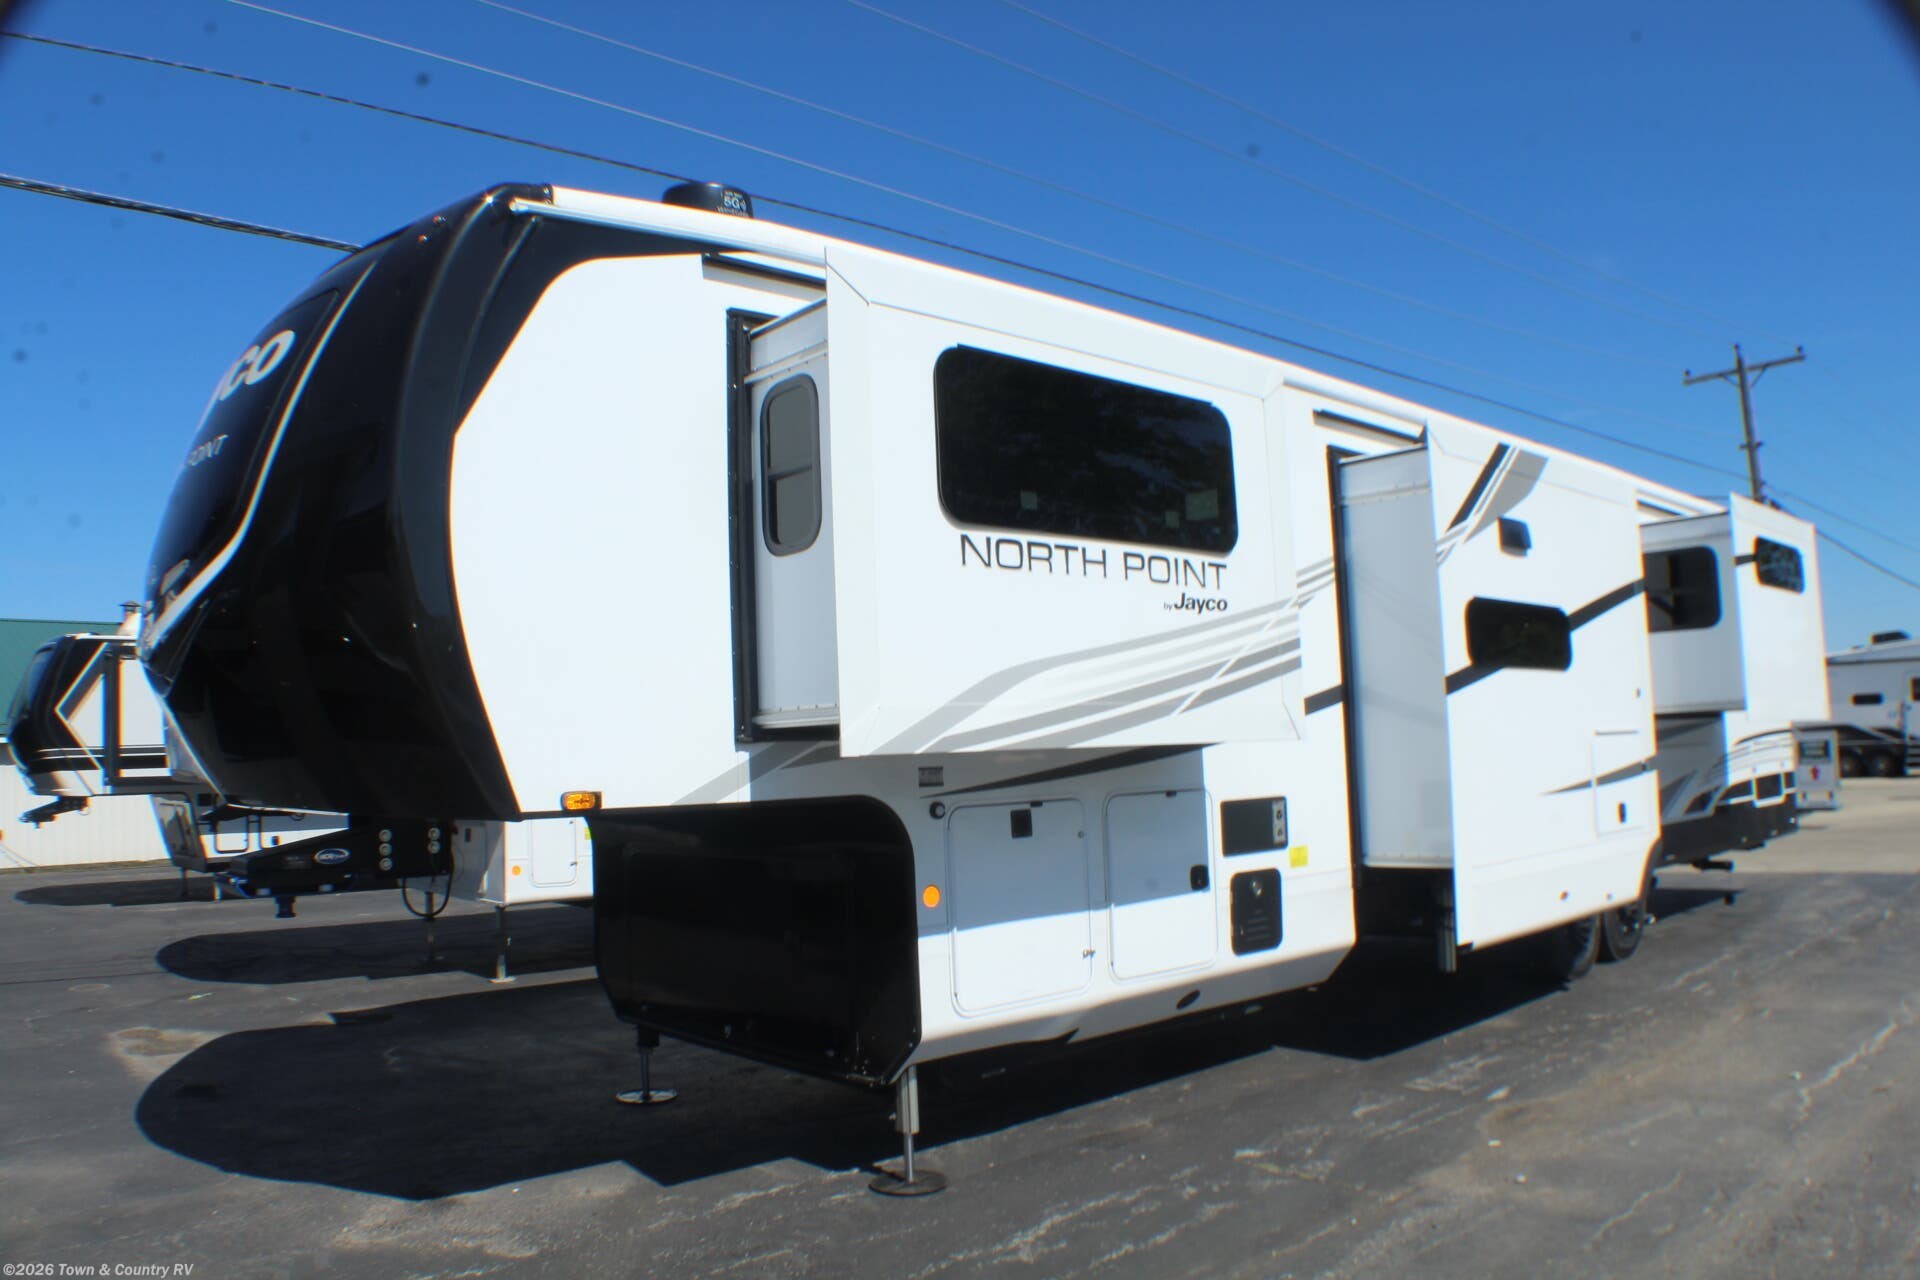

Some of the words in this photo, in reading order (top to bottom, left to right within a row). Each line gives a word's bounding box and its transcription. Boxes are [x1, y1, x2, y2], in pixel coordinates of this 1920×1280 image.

[960, 533, 1107, 578] NORTH
[1122, 551, 1228, 590] POINT
[1163, 601, 1173, 611] by
[1174, 592, 1228, 614] Jayco
